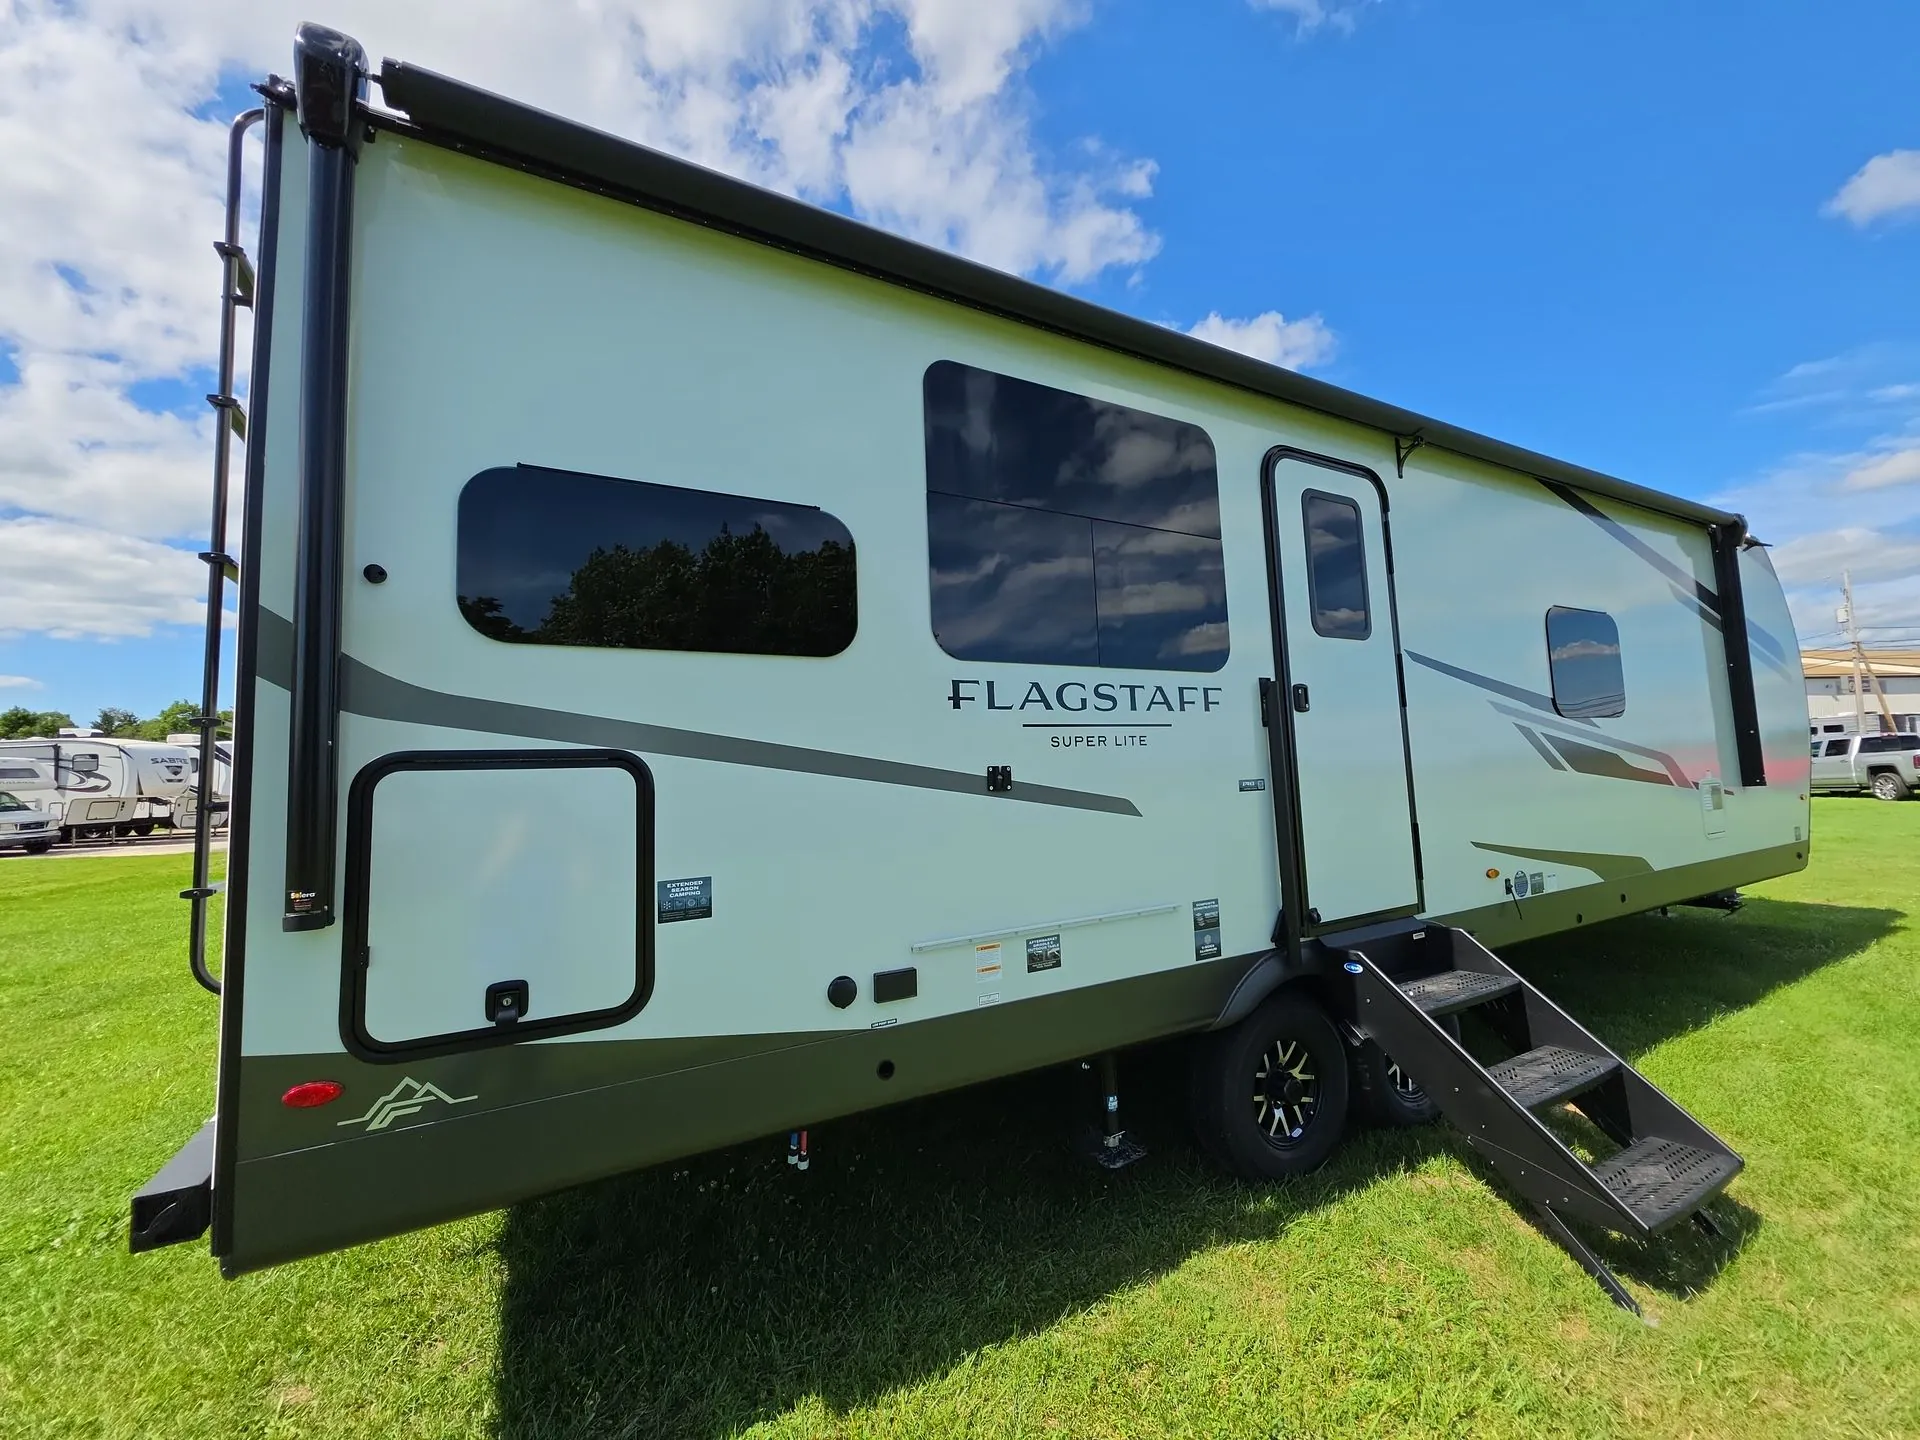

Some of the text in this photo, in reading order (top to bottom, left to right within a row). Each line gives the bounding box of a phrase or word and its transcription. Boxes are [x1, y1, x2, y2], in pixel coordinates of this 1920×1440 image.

[948, 679, 1222, 712] FLAGSTAFF
[1050, 735, 1148, 748] SUPER LITE
[150, 757, 189, 765] SABRE
[666, 880, 703, 889] EXTENDED
[671, 885, 700, 893] SEASON
[290, 891, 316, 899] Solera
[669, 890, 701, 898] CAMPING
